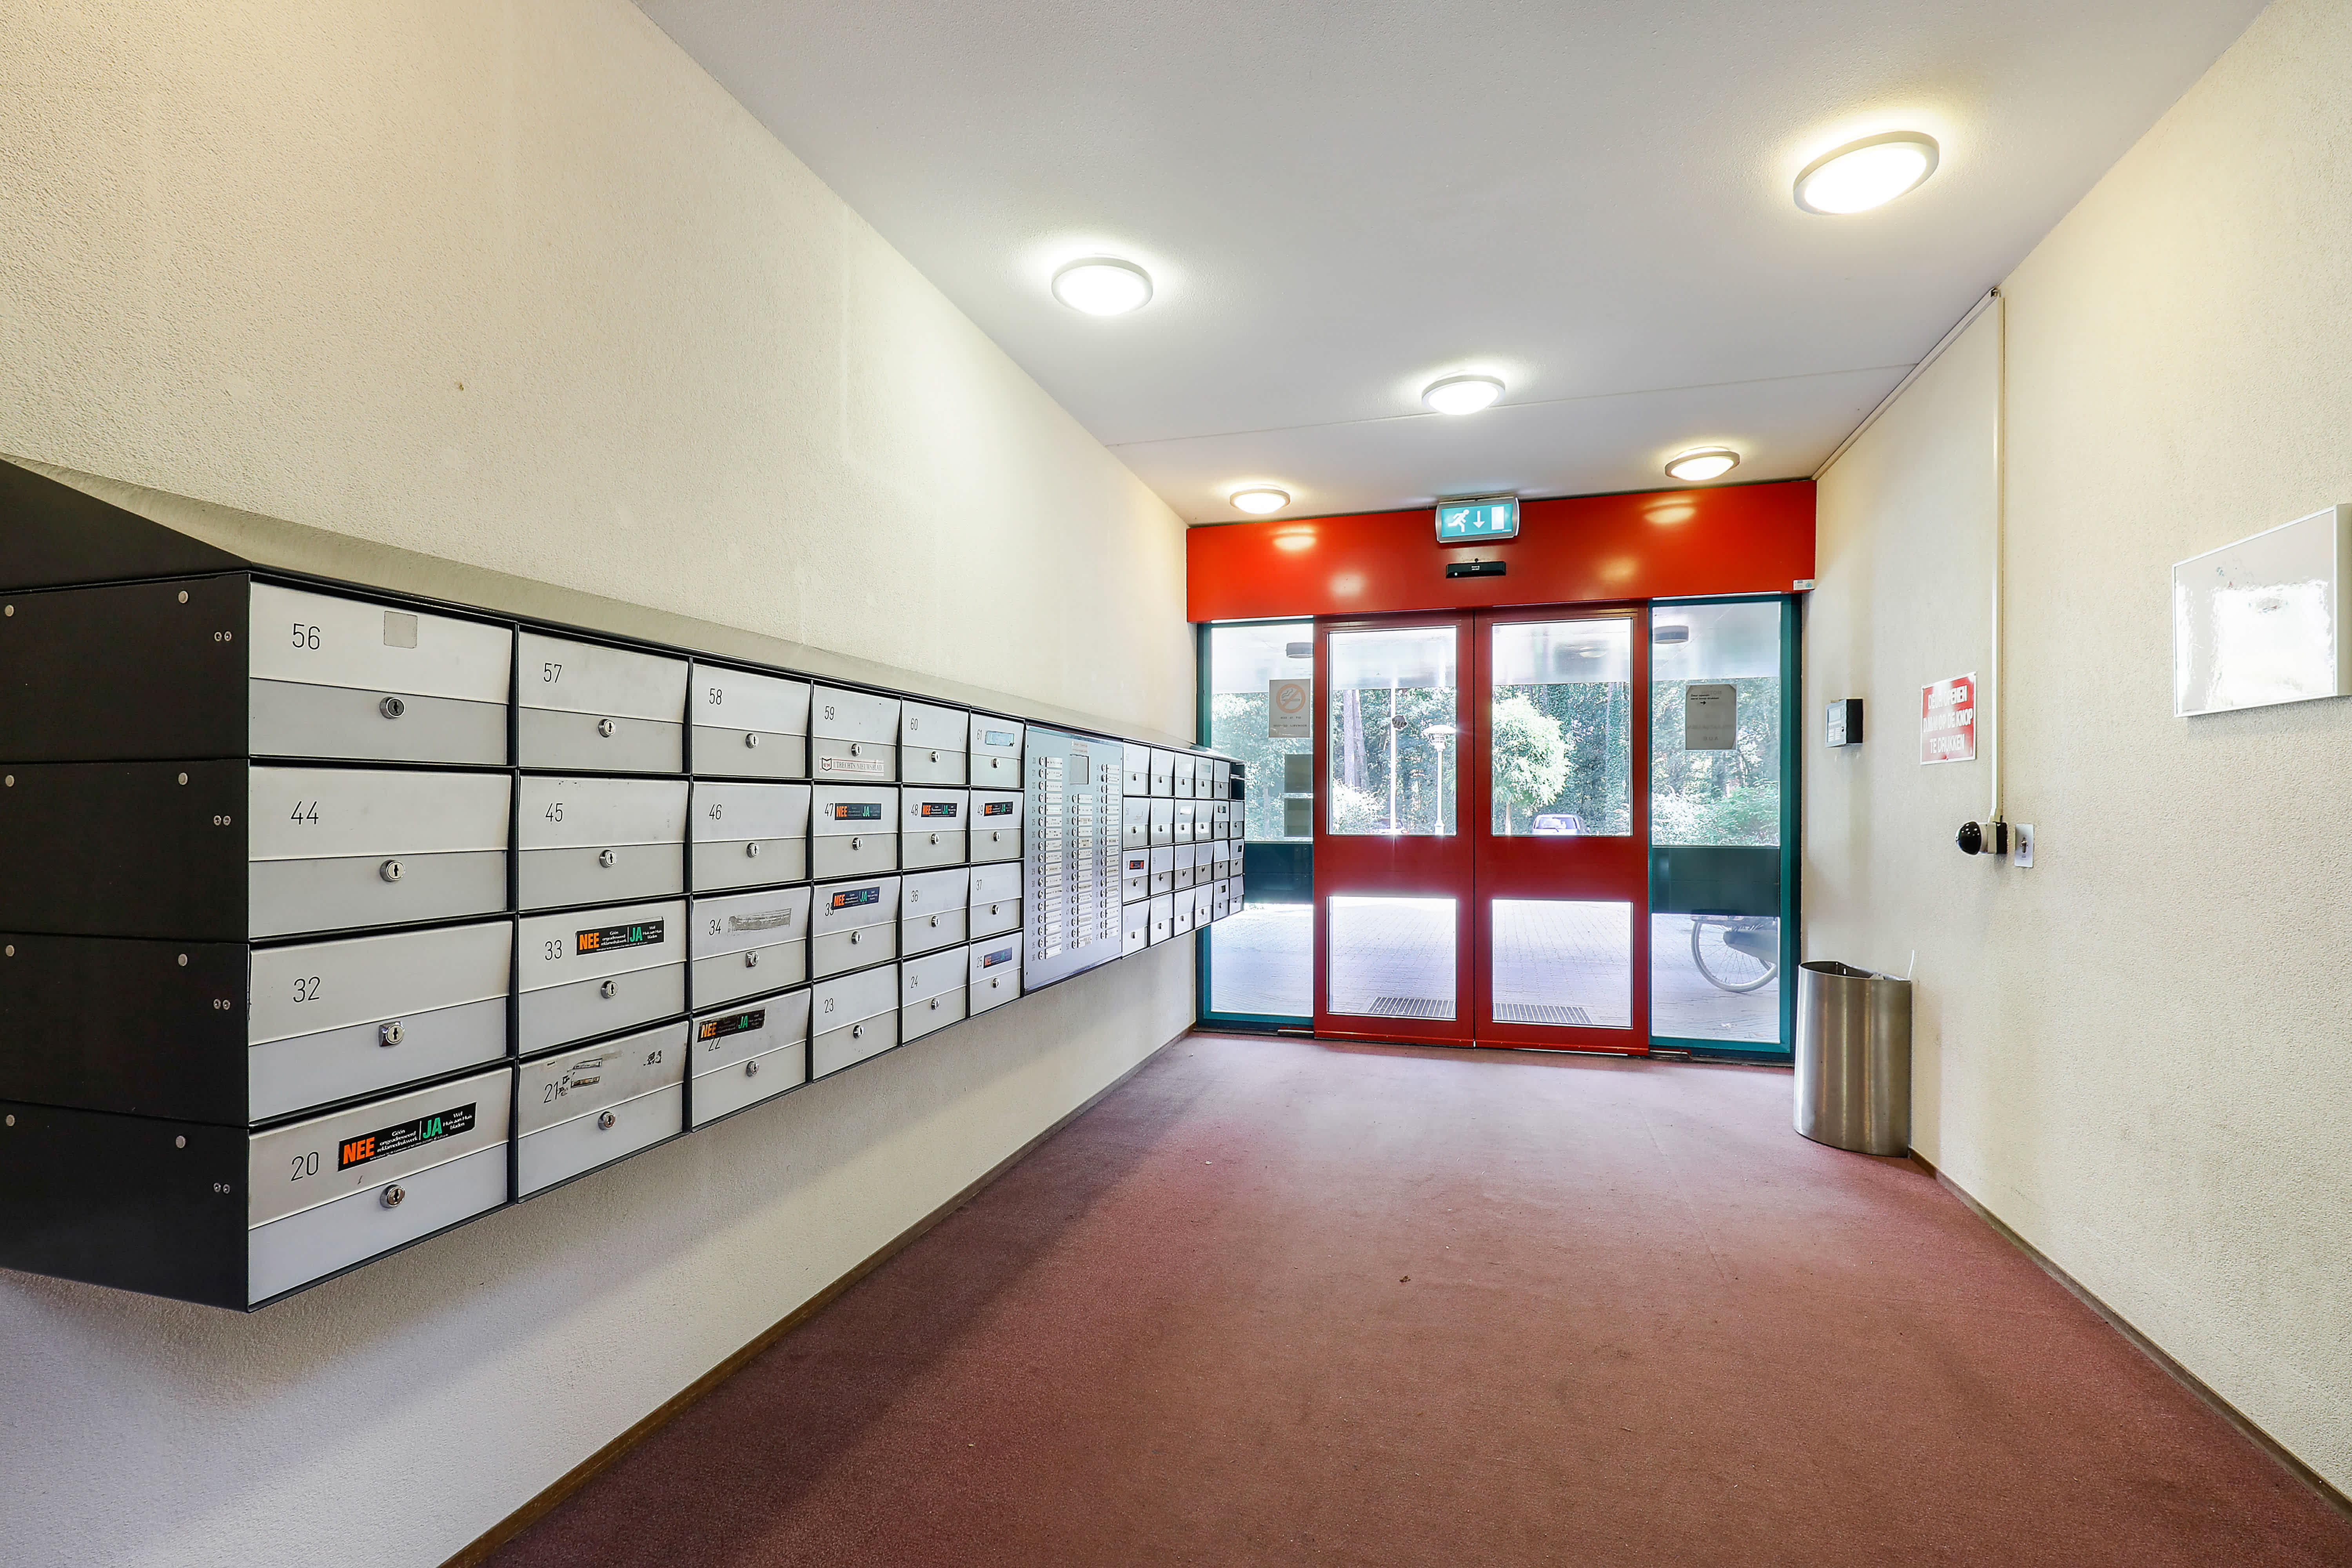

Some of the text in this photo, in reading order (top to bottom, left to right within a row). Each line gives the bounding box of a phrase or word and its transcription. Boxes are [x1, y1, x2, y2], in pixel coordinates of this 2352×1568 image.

[292, 623, 320, 650] 56
[543, 662, 562, 683] 57
[709, 688, 722, 705] 58
[825, 706, 834, 720] 59
[1947, 711, 1956, 728] DE
[1956, 708, 1973, 728] KNOP
[910, 718, 918, 731] 60
[977, 729, 982, 740] 61
[1929, 734, 1965, 753] TE DRUKKEN
[291, 801, 319, 825] 44
[545, 803, 563, 822] 45
[709, 804, 722, 820] 46
[825, 803, 834, 817] 47
[836, 806, 847, 817] NEE
[863, 806, 870, 817] JA
[911, 804, 918, 816] 48
[922, 805, 932, 815] NEE
[942, 805, 948, 814] JA
[977, 805, 983, 816] 49
[976, 879, 982, 891] 37
[834, 894, 845, 907] NEE
[860, 891, 867, 902] JA
[911, 890, 919, 902] 36
[630, 927, 643, 942] JA
[709, 918, 721, 936] 34
[579, 932, 599, 951] NEE
[545, 940, 562, 960] 33
[977, 956, 983, 968] 25
[910, 975, 918, 988] 24
[293, 976, 320, 1003] 32
[824, 998, 834, 1013] 23
[701, 1022, 717, 1038] NEE
[738, 1016, 748, 1029] JA
[543, 1082, 558, 1103] 21
[423, 1117, 442, 1139] JA
[343, 1137, 375, 1164] NEE
[291, 1152, 319, 1181] 20
